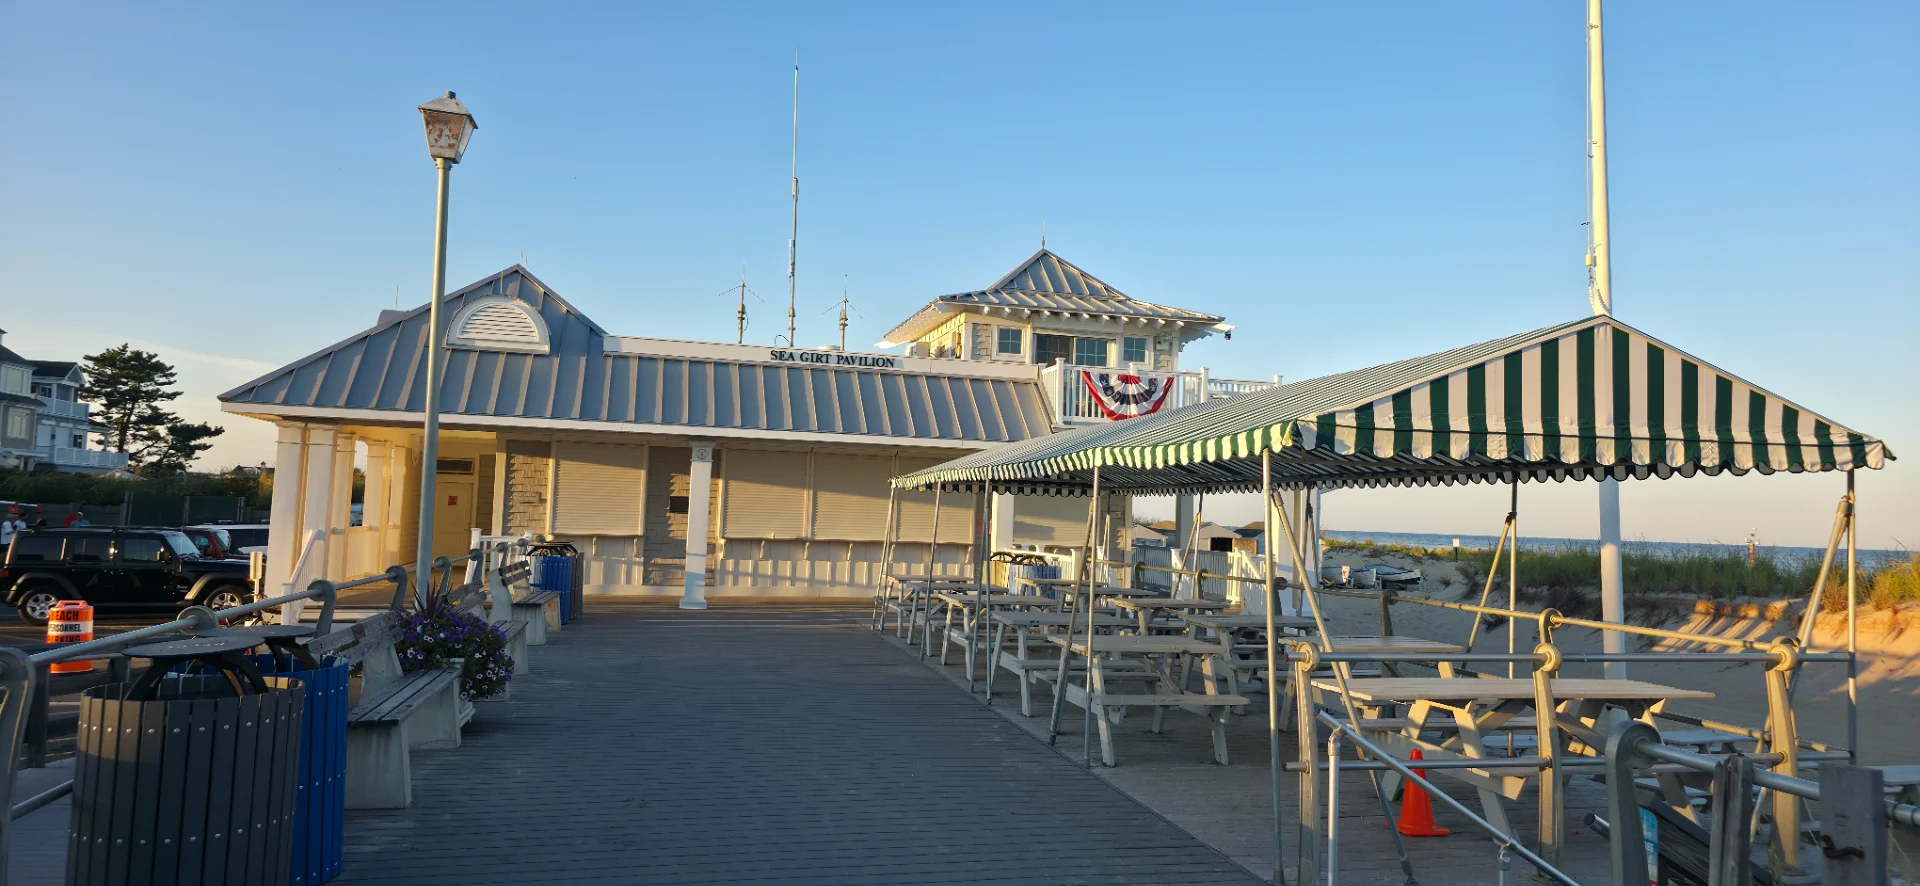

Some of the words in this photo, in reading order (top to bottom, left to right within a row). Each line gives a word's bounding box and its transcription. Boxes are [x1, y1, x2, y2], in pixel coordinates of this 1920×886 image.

[770, 350, 796, 361] SEA
[799, 351, 832, 364] GIRT
[836, 355, 896, 368] PAVILION
[51, 610, 79, 621] BEACH
[48, 623, 82, 632] PERSONNEL
